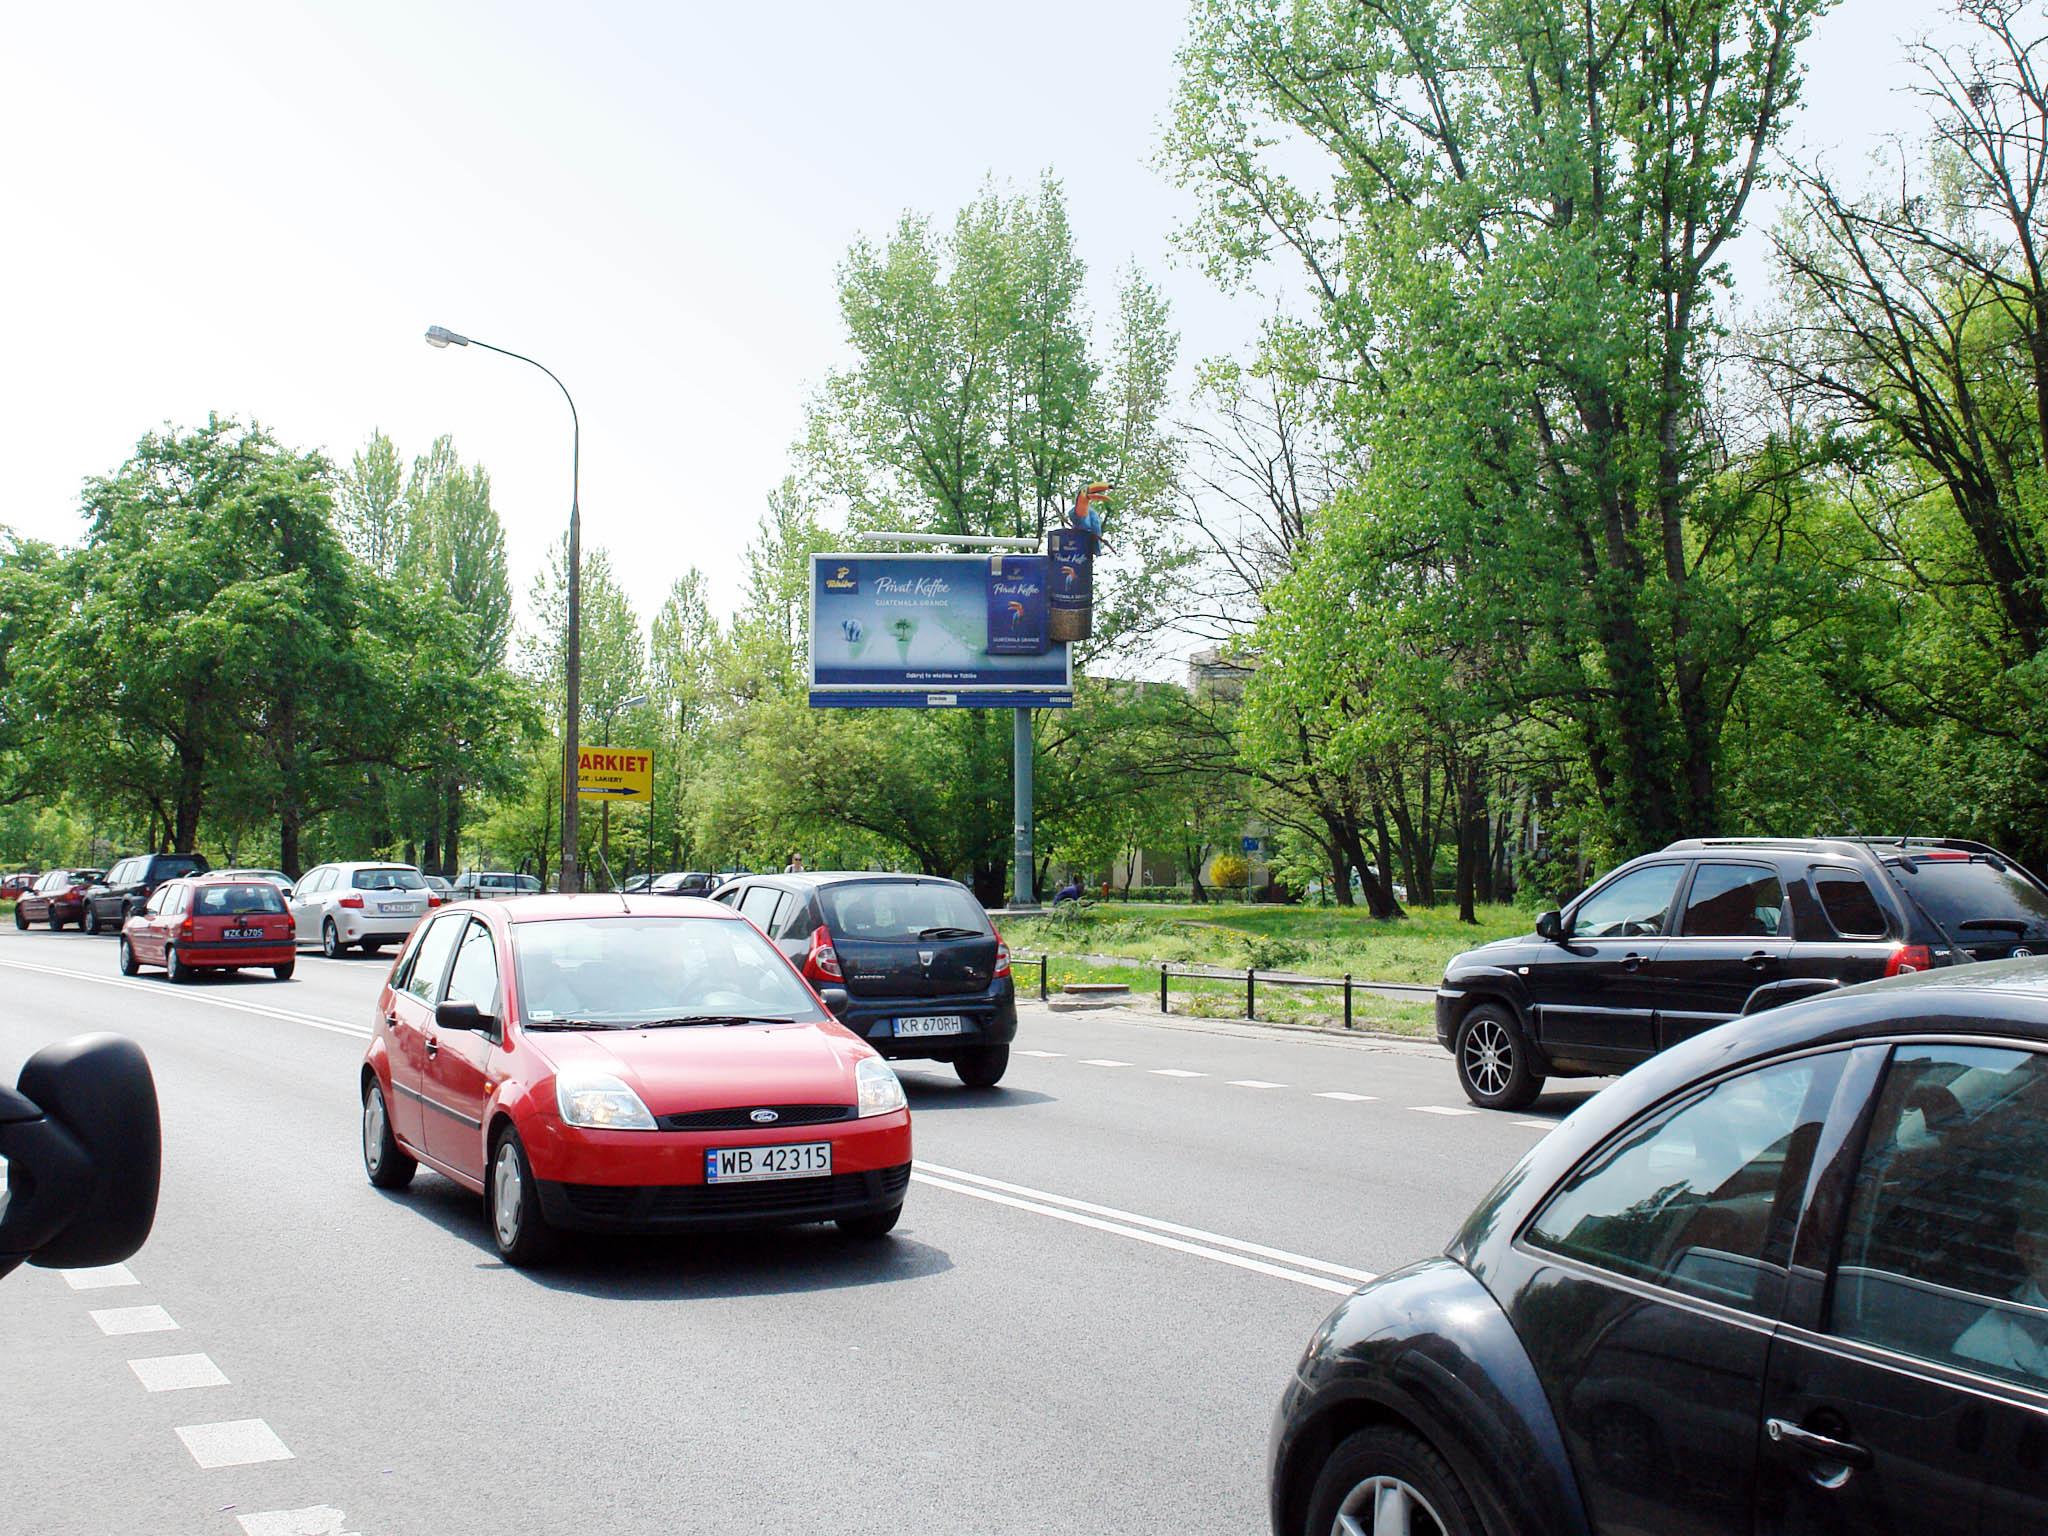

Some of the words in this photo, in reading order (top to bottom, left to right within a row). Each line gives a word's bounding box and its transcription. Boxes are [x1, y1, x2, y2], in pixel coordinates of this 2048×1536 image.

[874, 577, 913, 595] Privat
[914, 577, 951, 597] Kaffee
[875, 599, 917, 607] GUATEMALA
[901, 1018, 920, 1033] KR
[922, 1016, 959, 1032] 670RH
[721, 1151, 753, 1175] WB
[762, 1146, 827, 1172] 42315
